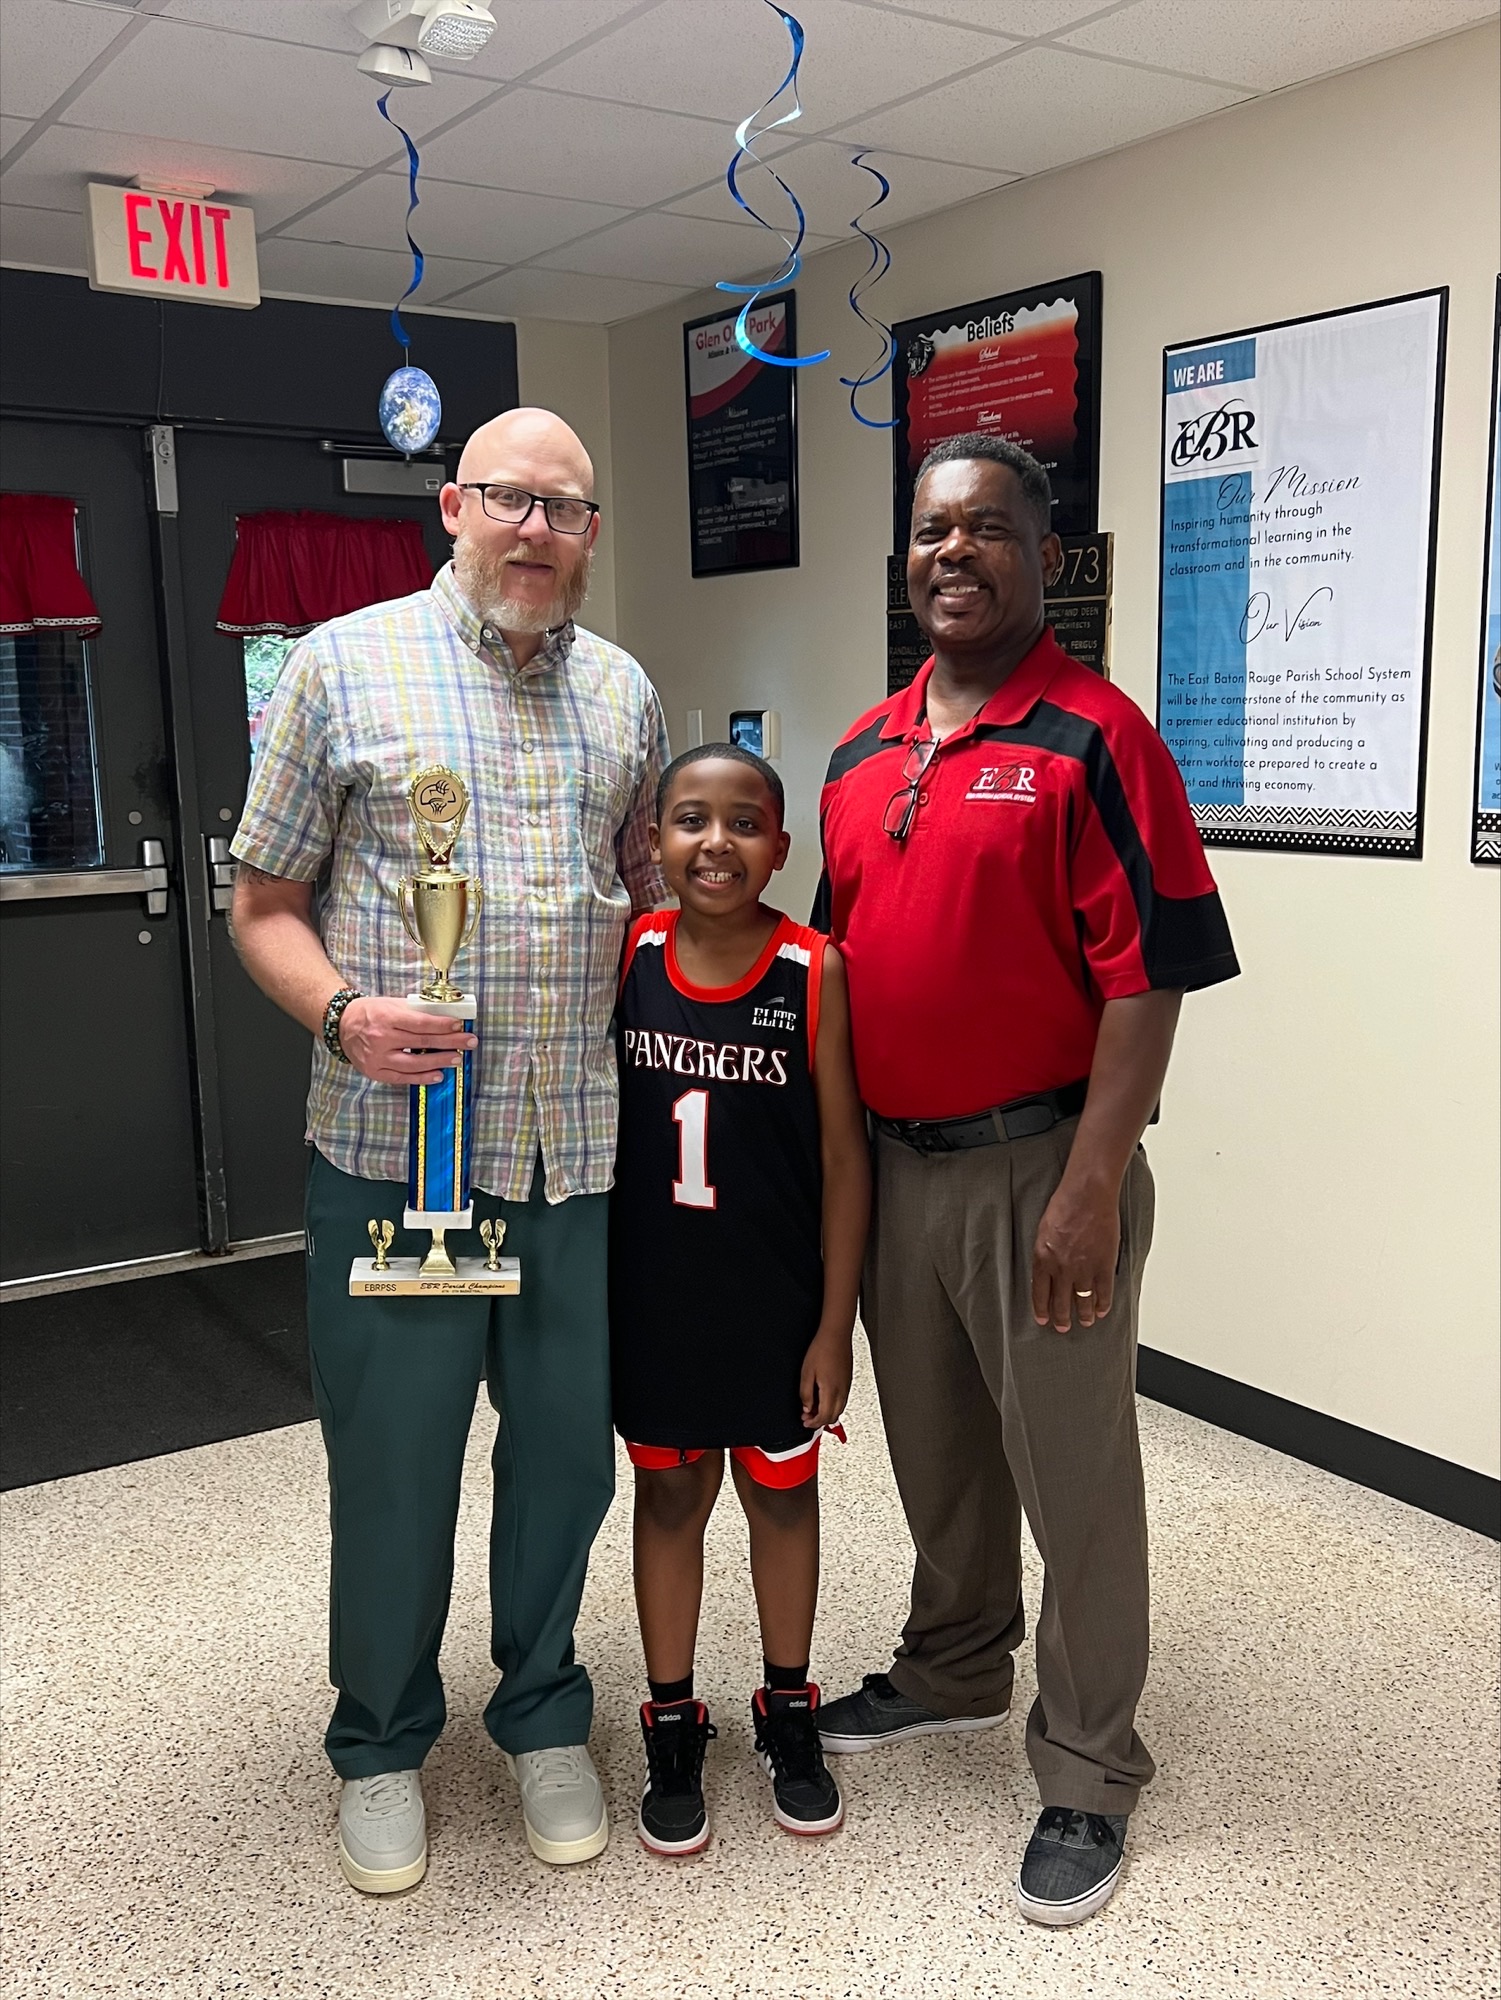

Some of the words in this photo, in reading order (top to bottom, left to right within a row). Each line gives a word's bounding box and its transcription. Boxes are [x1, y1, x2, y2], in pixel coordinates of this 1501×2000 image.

[124, 192, 231, 289] EXIT
[696, 330, 720, 350] Glen
[749, 311, 777, 336] Park
[967, 312, 1014, 342] Beliefs
[1174, 365, 1195, 388] WE
[1197, 360, 1225, 384] ARE
[1170, 398, 1259, 467] EBR
[1216, 474, 1255, 510] Our
[1264, 465, 1363, 503] Mission
[1171, 517, 1215, 533] Inspiring
[1219, 511, 1271, 526] humanity
[1275, 501, 1323, 519] through
[1170, 531, 1261, 554] transformational
[1264, 529, 1312, 544] learning
[1316, 526, 1327, 539] in
[1332, 522, 1352, 537] the
[889, 564, 907, 582] GL
[1169, 560, 1221, 576] classroom
[1224, 556, 1245, 570] and
[1250, 557, 1260, 569] in
[1264, 553, 1282, 567] the
[1285, 548, 1354, 566] community.
[1081, 606, 1099, 616] DEEN
[1239, 591, 1279, 644] Our
[1285, 586, 1333, 642] Vision
[889, 619, 906, 630] EAST
[1071, 640, 1098, 650] FERGUS
[1168, 673, 1185, 685] The
[1188, 672, 1210, 685] East
[1214, 671, 1244, 684] Baton
[1248, 671, 1282, 686] Rouge
[1286, 668, 1321, 681] Parish
[1325, 666, 1363, 681] School
[1367, 666, 1411, 682] System
[1167, 692, 1182, 706] will
[1185, 692, 1198, 706] be
[1201, 692, 1217, 705] the
[1220, 694, 1282, 705] cornerstone
[1285, 690, 1297, 704] of
[1301, 690, 1319, 704] the
[1323, 691, 1387, 706] community
[1391, 693, 1405, 703] as
[1166, 718, 1173, 727] a
[1176, 716, 1214, 729] premier
[1217, 713, 1279, 726] educational
[1282, 715, 1338, 726] institution
[1342, 712, 1356, 729] by
[1166, 736, 1210, 750] inspiring,
[1213, 734, 1268, 750] cultivating
[1271, 734, 1293, 747] and
[1296, 734, 1353, 751] producing
[1357, 739, 1365, 748] a
[1175, 754, 1203, 767] odern
[1206, 754, 1255, 768] workforce
[1259, 755, 1310, 771] prepared
[1314, 759, 1325, 769] to
[1328, 759, 1366, 770] create
[1369, 761, 1378, 770] a
[1198, 776, 1219, 788] and
[1222, 776, 1261, 792] thriving
[1264, 782, 1316, 793] economy.
[752, 1007, 797, 1031] ELITE
[624, 1029, 790, 1087] PANTHERS
[671, 1088, 717, 1209] 1
[364, 1283, 397, 1292] EBRPSS
[420, 1282, 441, 1290] EBR
[468, 1282, 506, 1290] Champions
[658, 1714, 682, 1722] adidas
